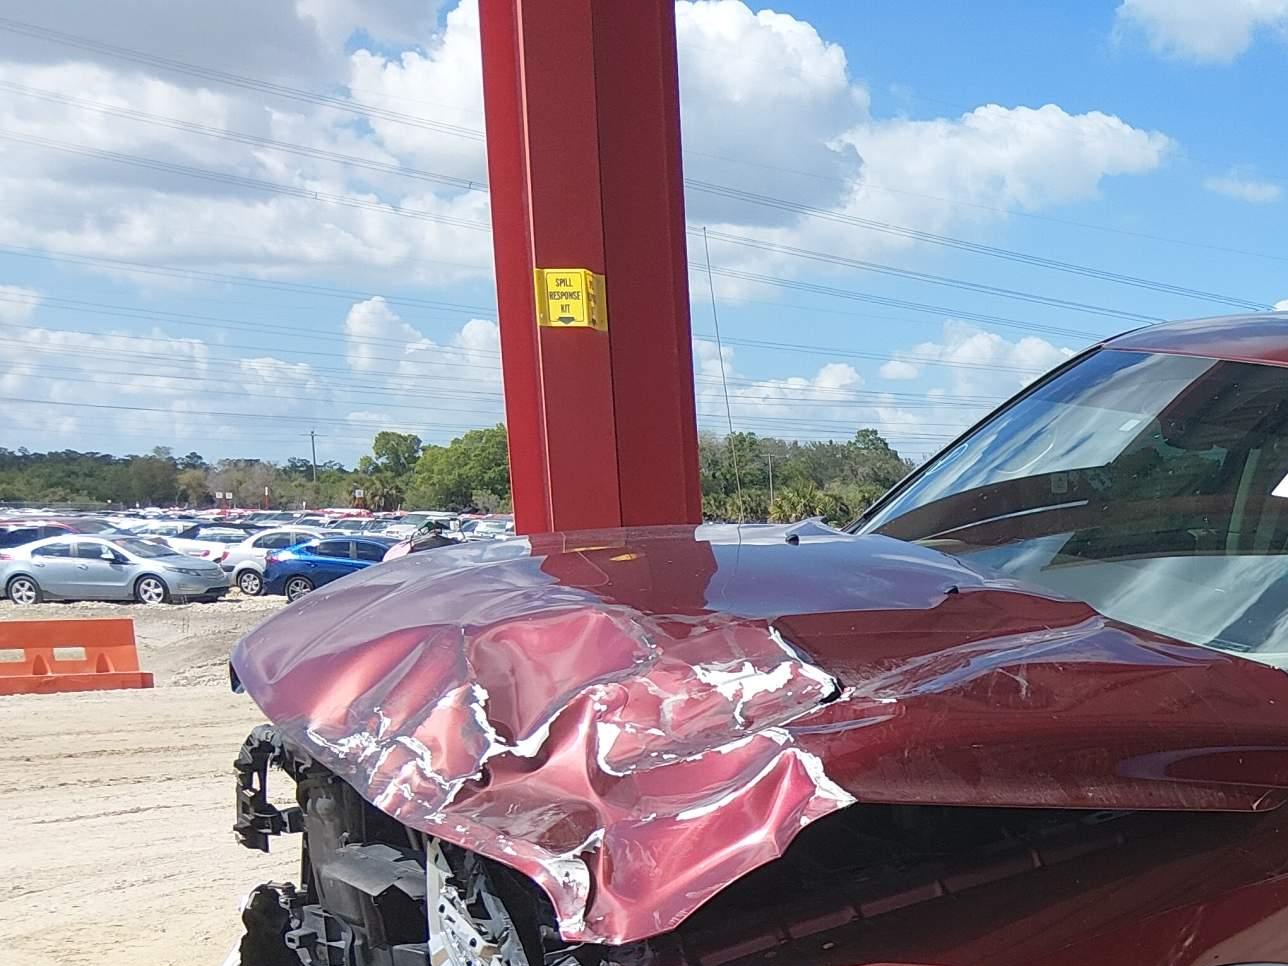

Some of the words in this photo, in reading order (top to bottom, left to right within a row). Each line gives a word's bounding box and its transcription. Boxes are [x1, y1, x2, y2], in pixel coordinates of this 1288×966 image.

[555, 278, 573, 288] SPILL
[549, 291, 581, 301] RESPONSE
[560, 304, 571, 313] KIT
